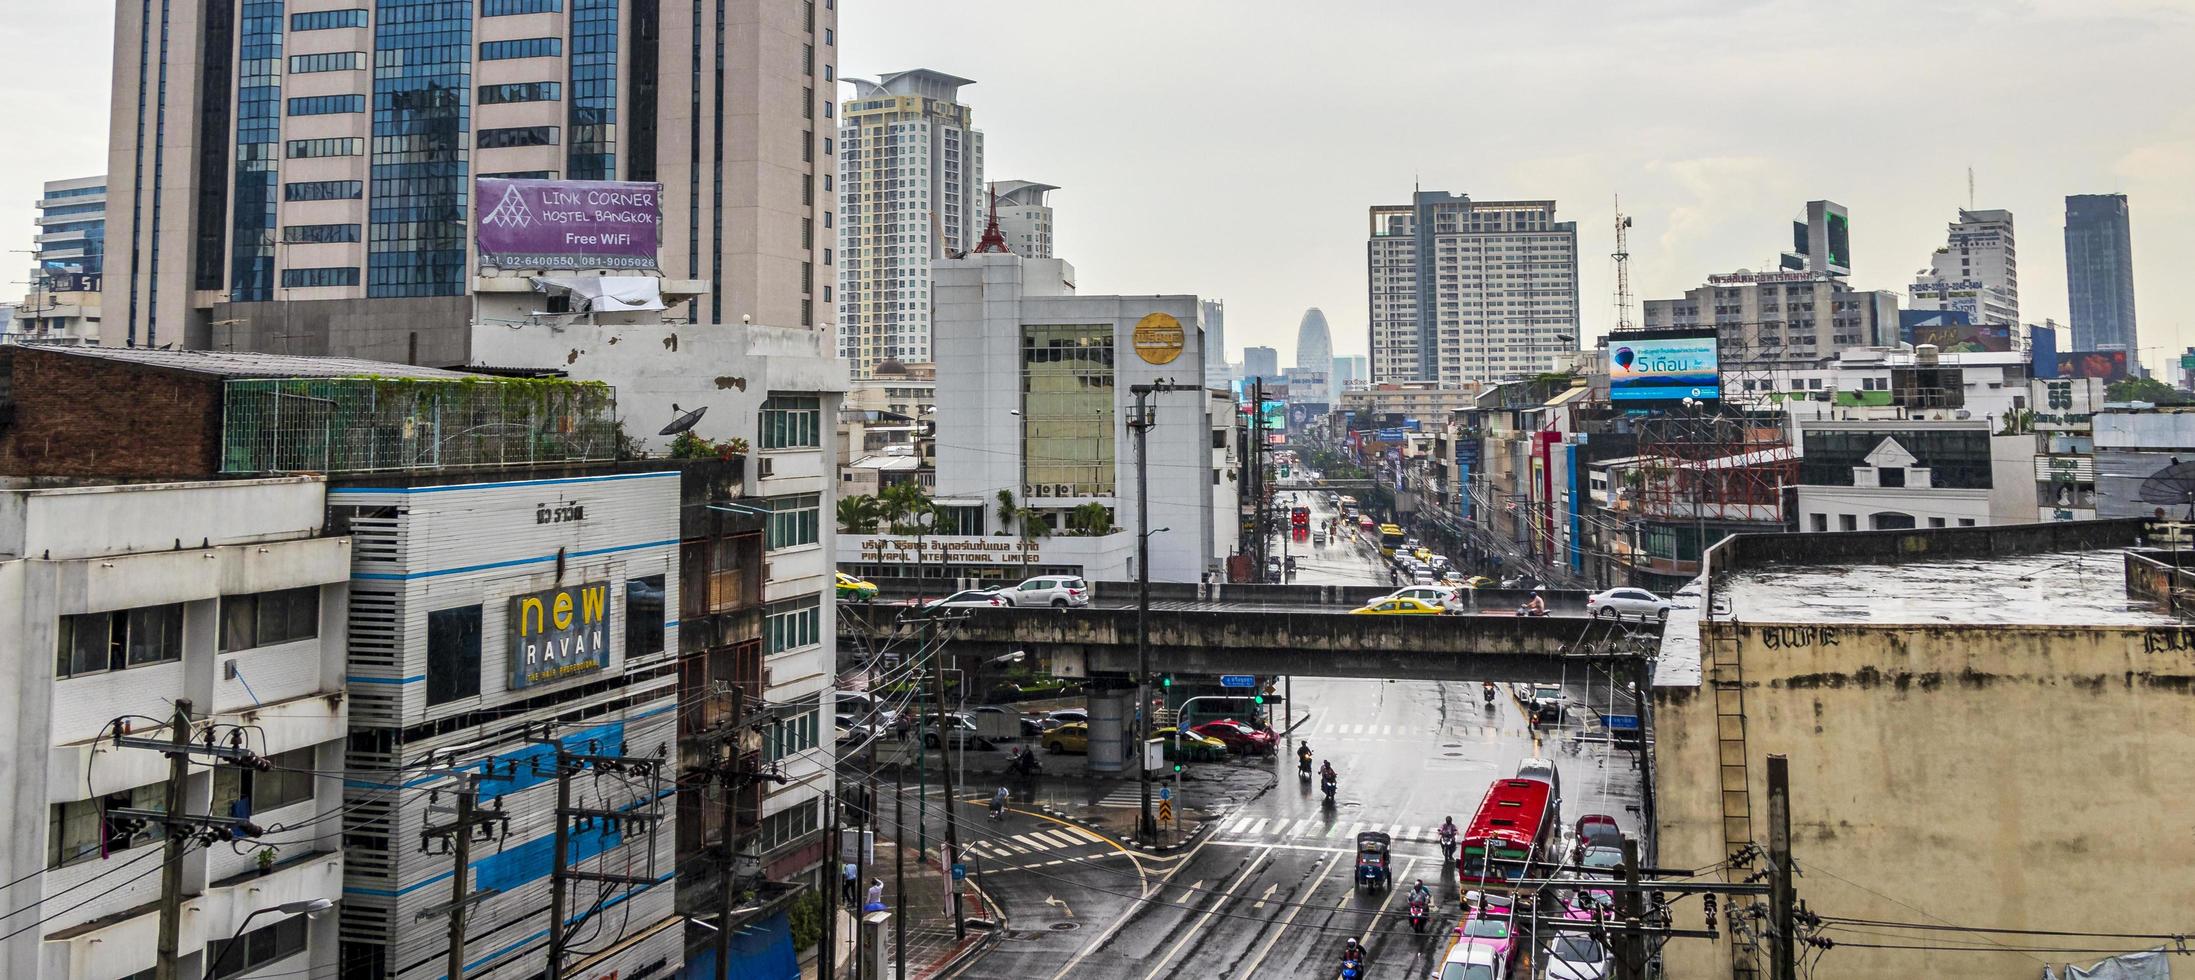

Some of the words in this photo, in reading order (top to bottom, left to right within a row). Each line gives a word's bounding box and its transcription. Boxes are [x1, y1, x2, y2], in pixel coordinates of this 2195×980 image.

[543, 191, 581, 205] LINK
[588, 191, 653, 206] CORNER
[543, 210, 590, 222] HOSTEL
[595, 211, 653, 223] BANGKOK
[566, 233, 597, 245] Free
[600, 233, 630, 245] WiFi
[581, 256, 655, 267] 081-9005026
[1638, 357, 1649, 372] 5
[1652, 356, 1688, 372] เดือน
[862, 553, 911, 561] PIRYAPUL
[919, 553, 993, 562] NTERNATIONAL
[521, 586, 605, 637] new
[527, 630, 602, 665] RAVAN
